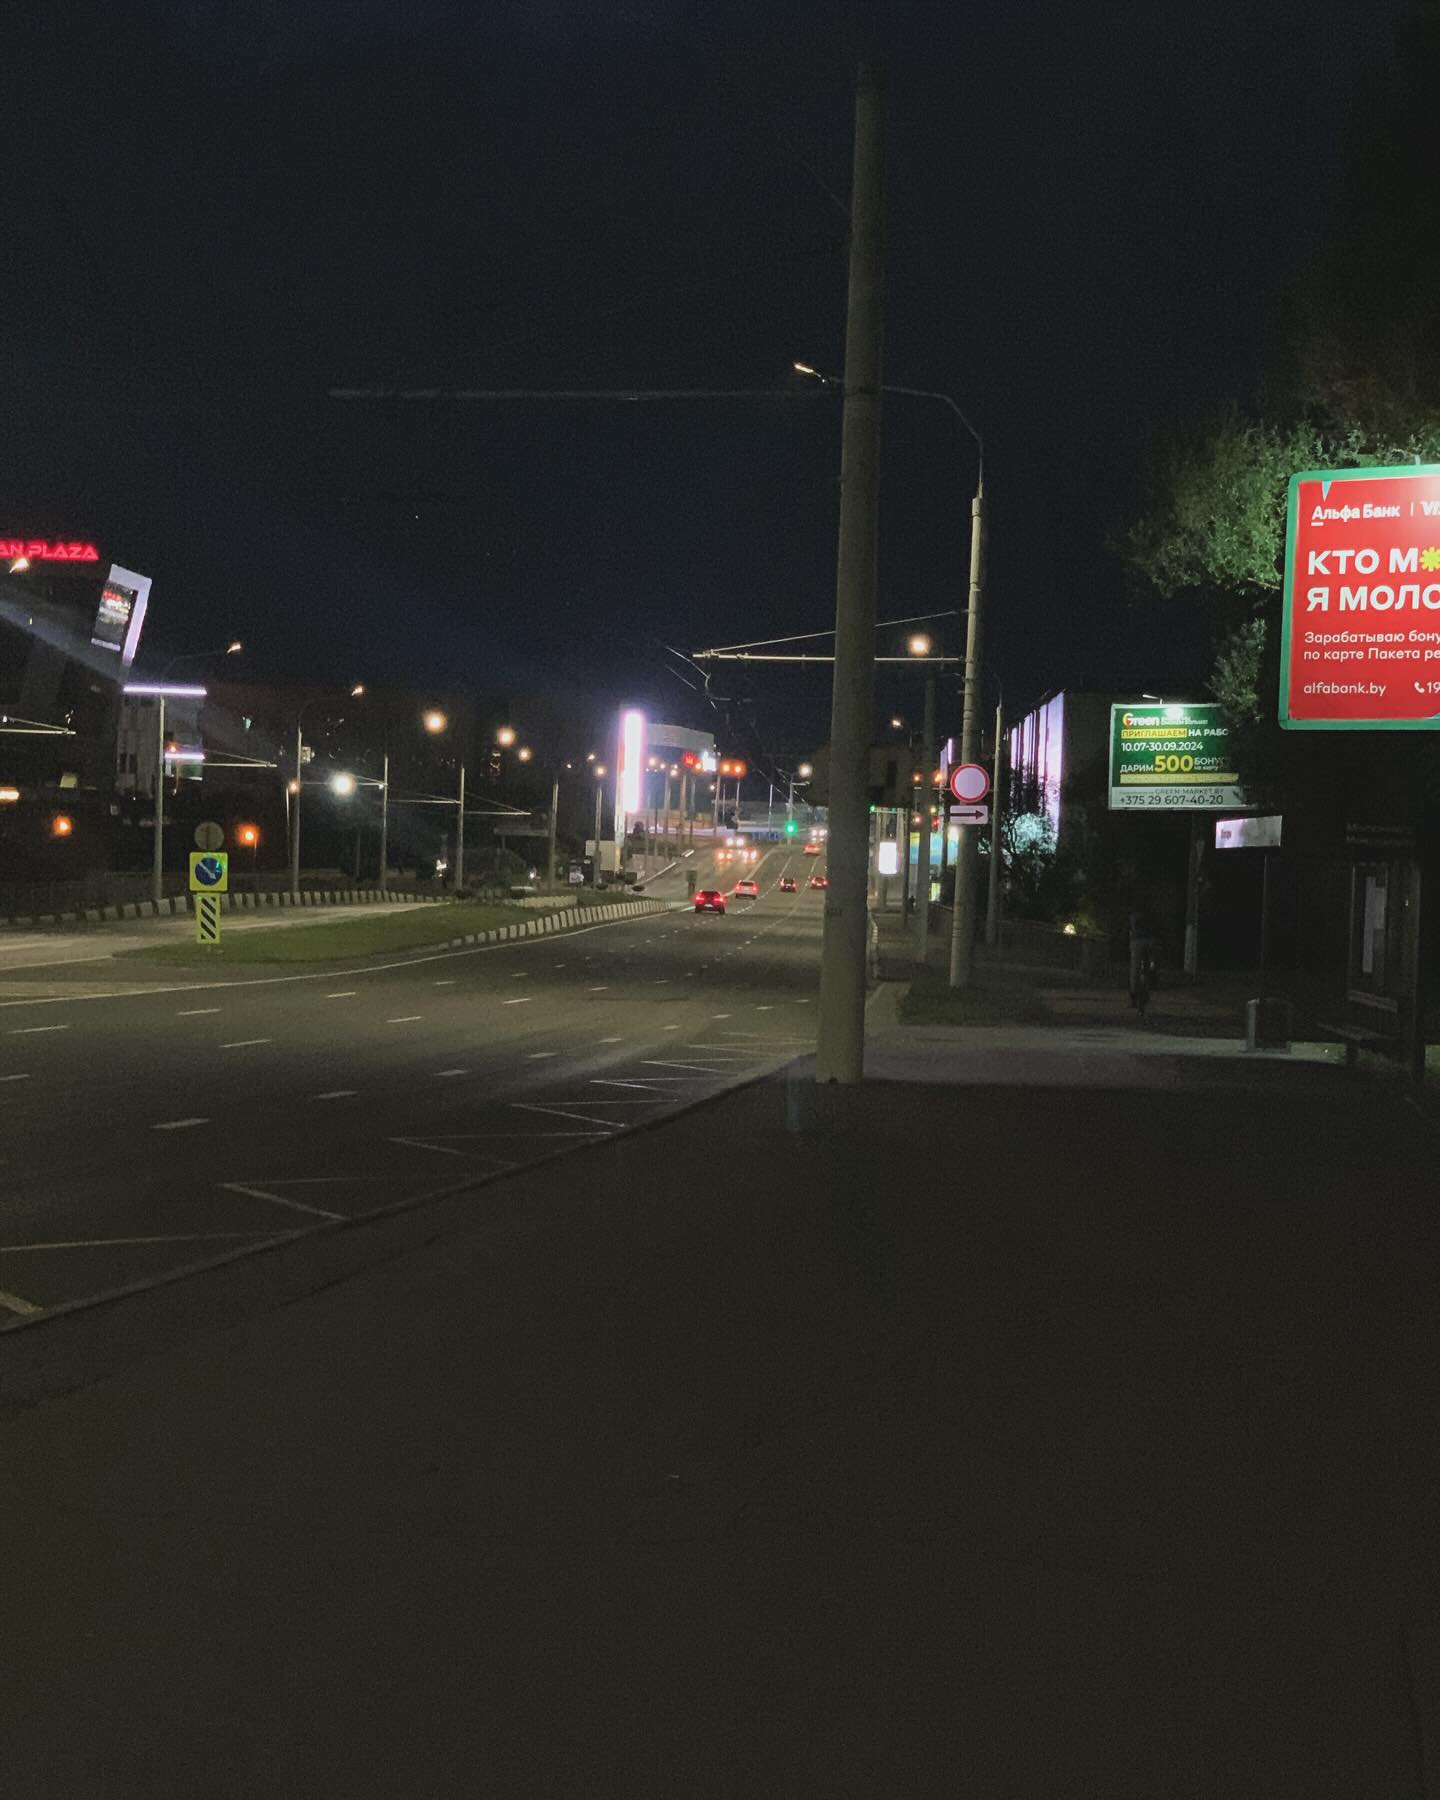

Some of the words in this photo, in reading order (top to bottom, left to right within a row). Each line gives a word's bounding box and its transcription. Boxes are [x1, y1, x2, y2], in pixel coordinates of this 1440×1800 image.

[1311, 504, 1360, 525] Альфа
[1363, 503, 1401, 519] Банк
[1420, 500, 1440, 516] VI
[27, 544, 100, 561] PLAZA
[1308, 548, 1380, 575] КТО
[1306, 587, 1330, 612] Я
[1339, 584, 1440, 612] МОЛО
[1304, 631, 1405, 645] Зарабатываю
[1303, 650, 1321, 660] по
[1323, 650, 1364, 662] карте
[1367, 647, 1421, 660] Пакета
[1303, 681, 1387, 697] alfabank.by
[1122, 712, 1160, 728] Green
[1121, 728, 1187, 738] ПРИГЛАШАЕМ
[1188, 728, 1202, 737] НА
[1203, 728, 1230, 737] РАБО
[1121, 740, 1204, 752] 10.07-30.09.2024
[1119, 764, 1154, 773] ДАРИМ
[1154, 754, 1194, 773] 500
[1194, 756, 1223, 765] БОНУ
[1119, 795, 1145, 805] +375
[1147, 795, 1162, 805] 29
[1164, 795, 1224, 805] 607-40-20
